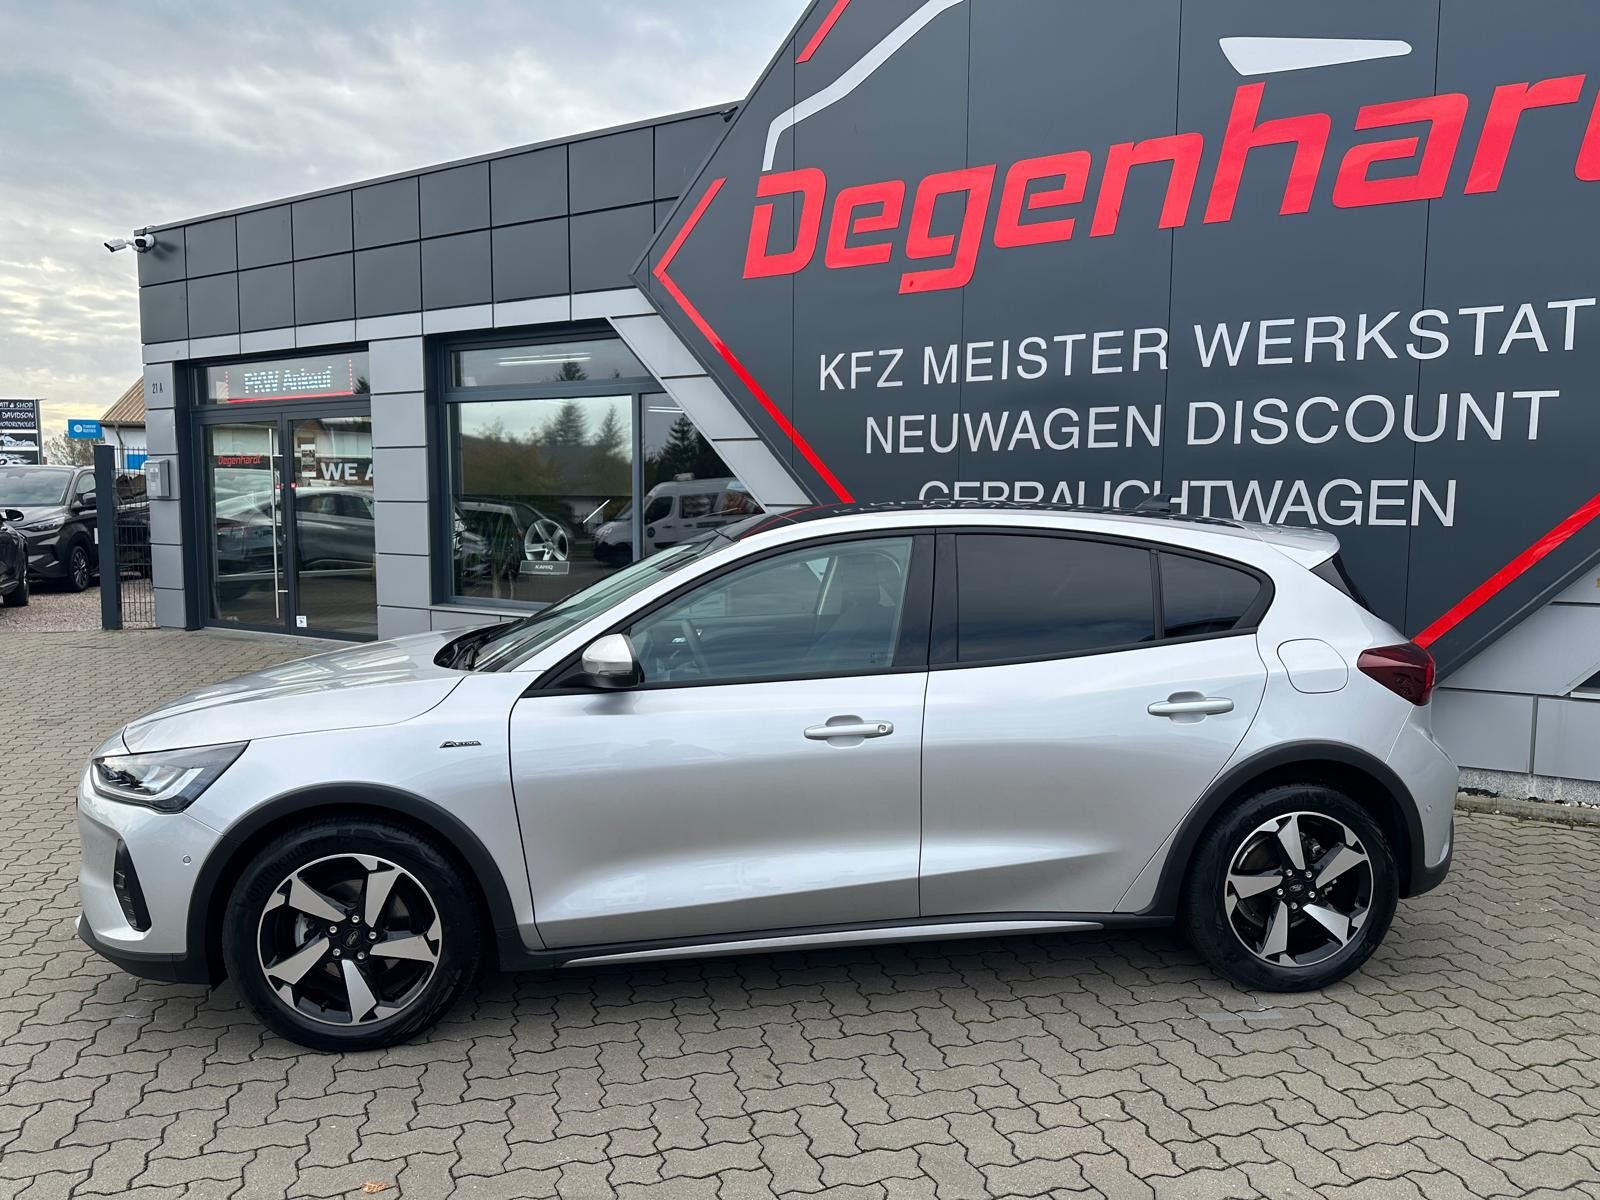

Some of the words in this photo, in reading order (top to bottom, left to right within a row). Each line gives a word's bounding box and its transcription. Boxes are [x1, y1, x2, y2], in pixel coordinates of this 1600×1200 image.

[744, 75, 1600, 293] Degenhar
[820, 349, 904, 391] KFZ
[924, 328, 1169, 384] MEISTER
[1194, 298, 1597, 371] WERKSTAT
[152, 383, 158, 394] 21
[867, 405, 1162, 453] NEUWAGEN
[1188, 390, 1560, 445] DISCOUNT
[320, 462, 358, 481] WE
